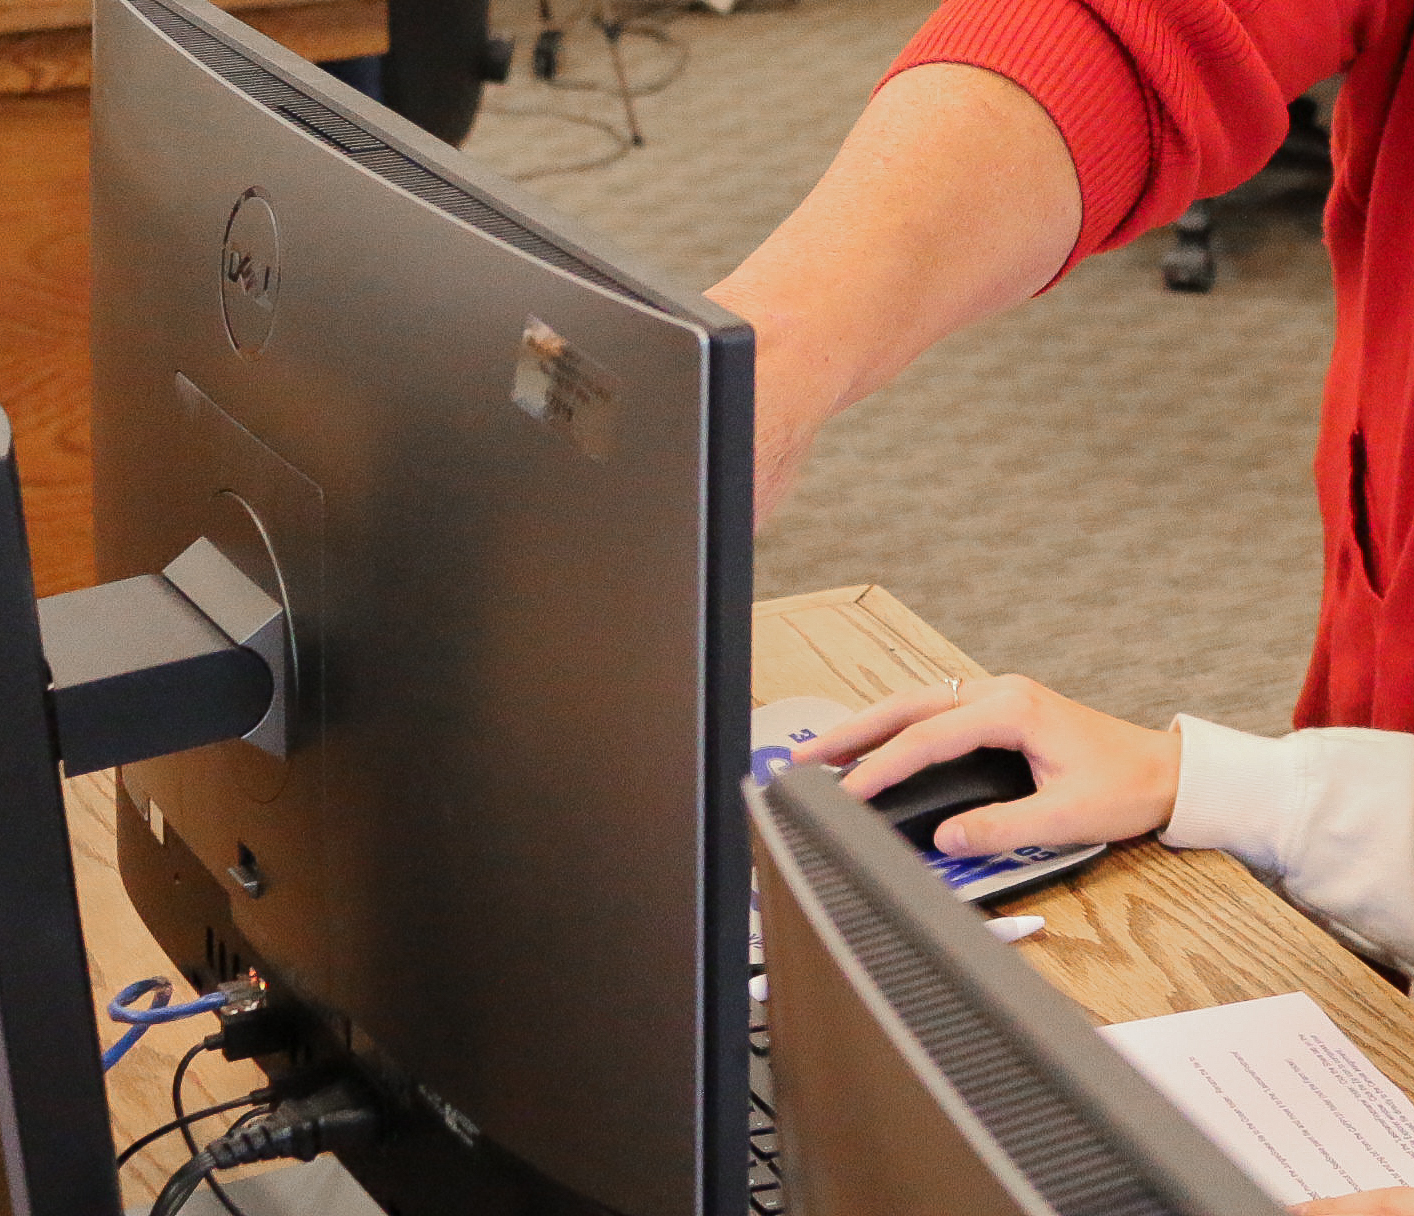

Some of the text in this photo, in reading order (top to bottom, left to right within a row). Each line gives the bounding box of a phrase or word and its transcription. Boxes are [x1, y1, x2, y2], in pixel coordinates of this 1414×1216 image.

[1198, 1068, 1209, 1076] the
[1245, 1122, 1257, 1130] the
[1353, 1132, 1364, 1141] the
[1360, 1140, 1373, 1152] from
[1399, 1143, 1411, 1152] the
[1382, 1164, 1396, 1173] and
[1288, 1169, 1299, 1178] the
